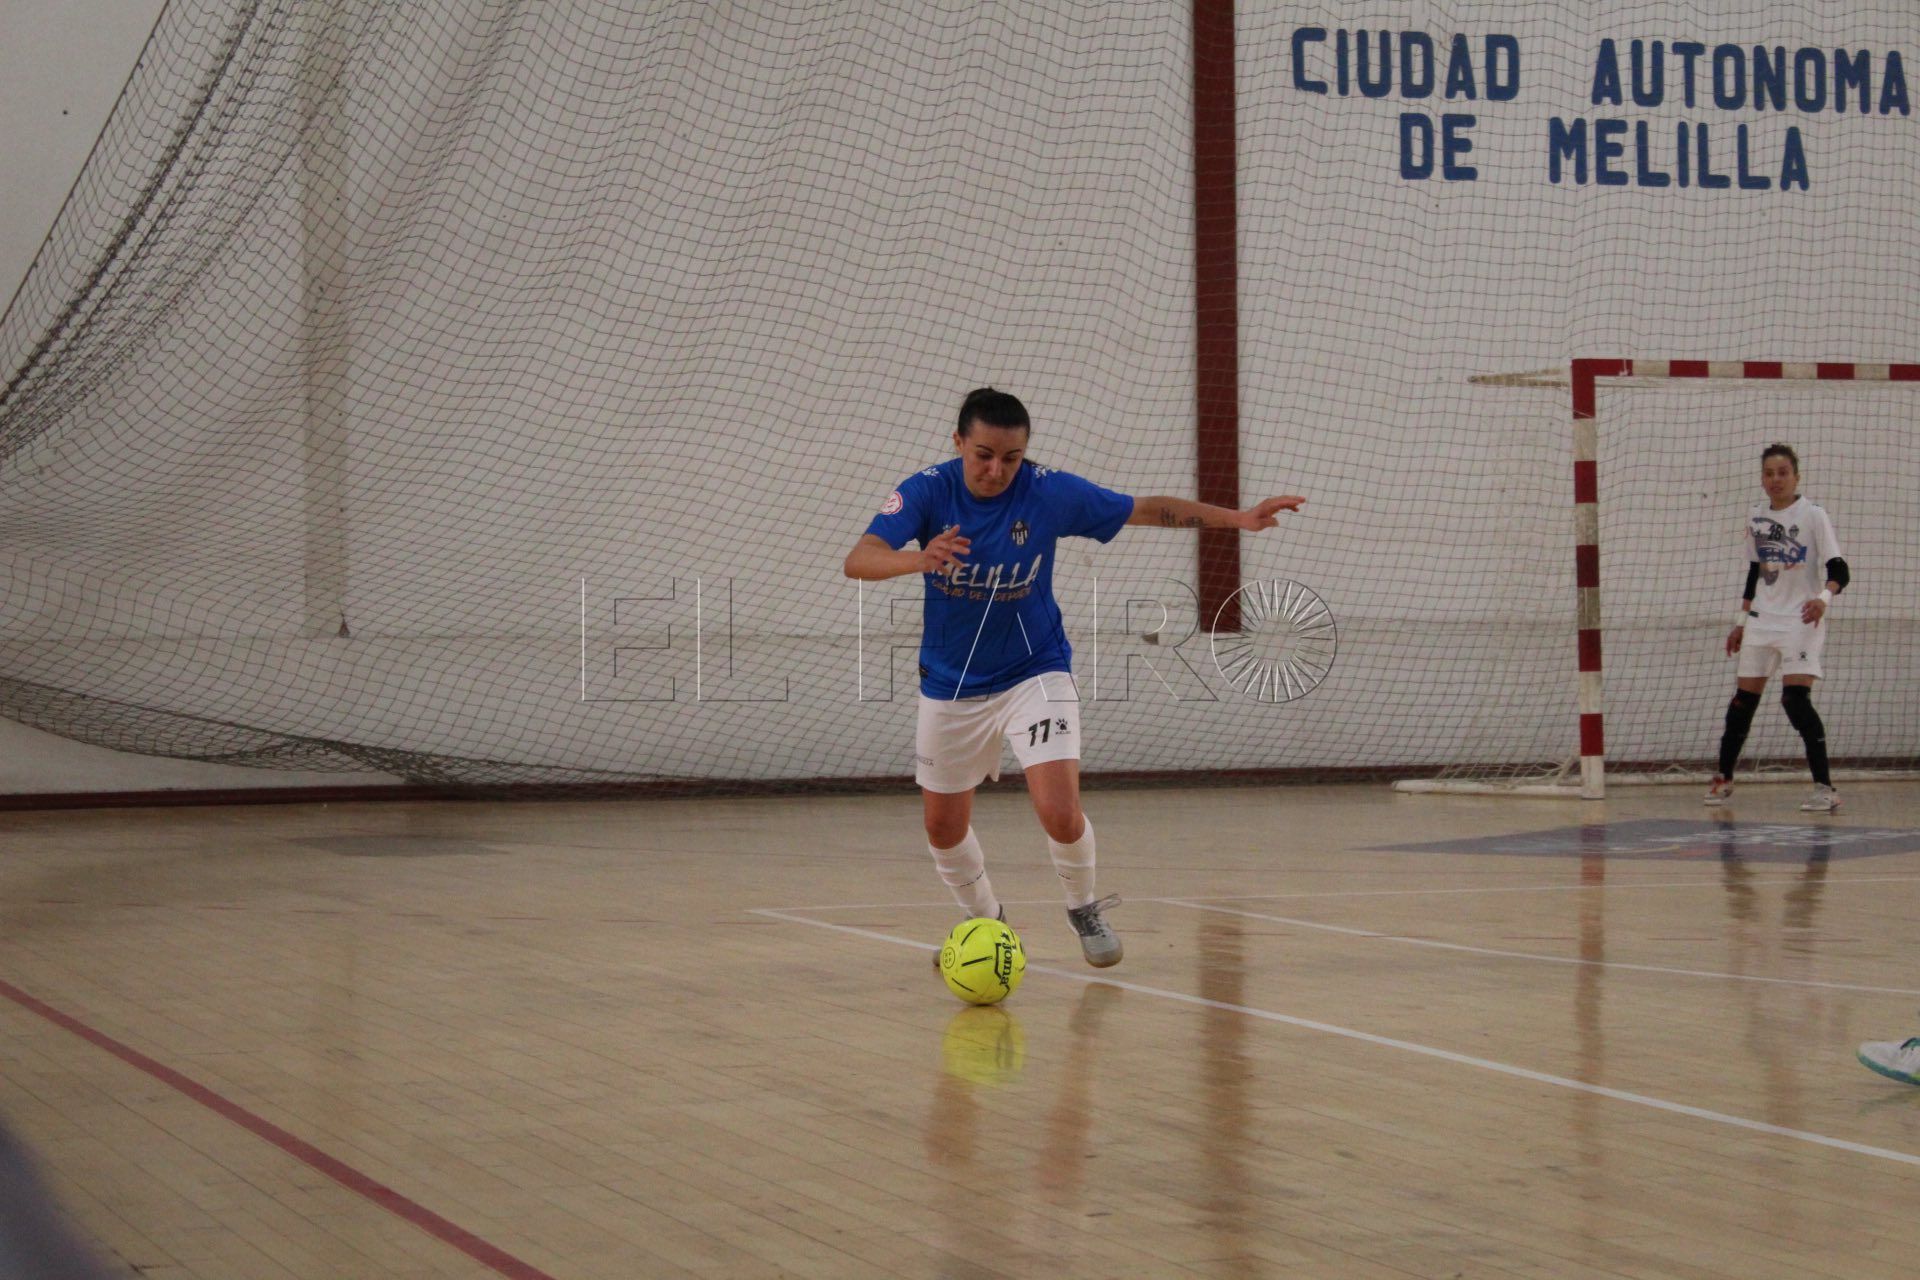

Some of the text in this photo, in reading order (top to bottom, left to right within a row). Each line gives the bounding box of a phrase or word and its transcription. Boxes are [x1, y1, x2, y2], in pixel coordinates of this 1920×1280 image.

[1292, 27, 1910, 117] CIUDAD AUTONOMA
[1399, 112, 1809, 191] DE MELILLA
[1028, 718, 1051, 748] 17
